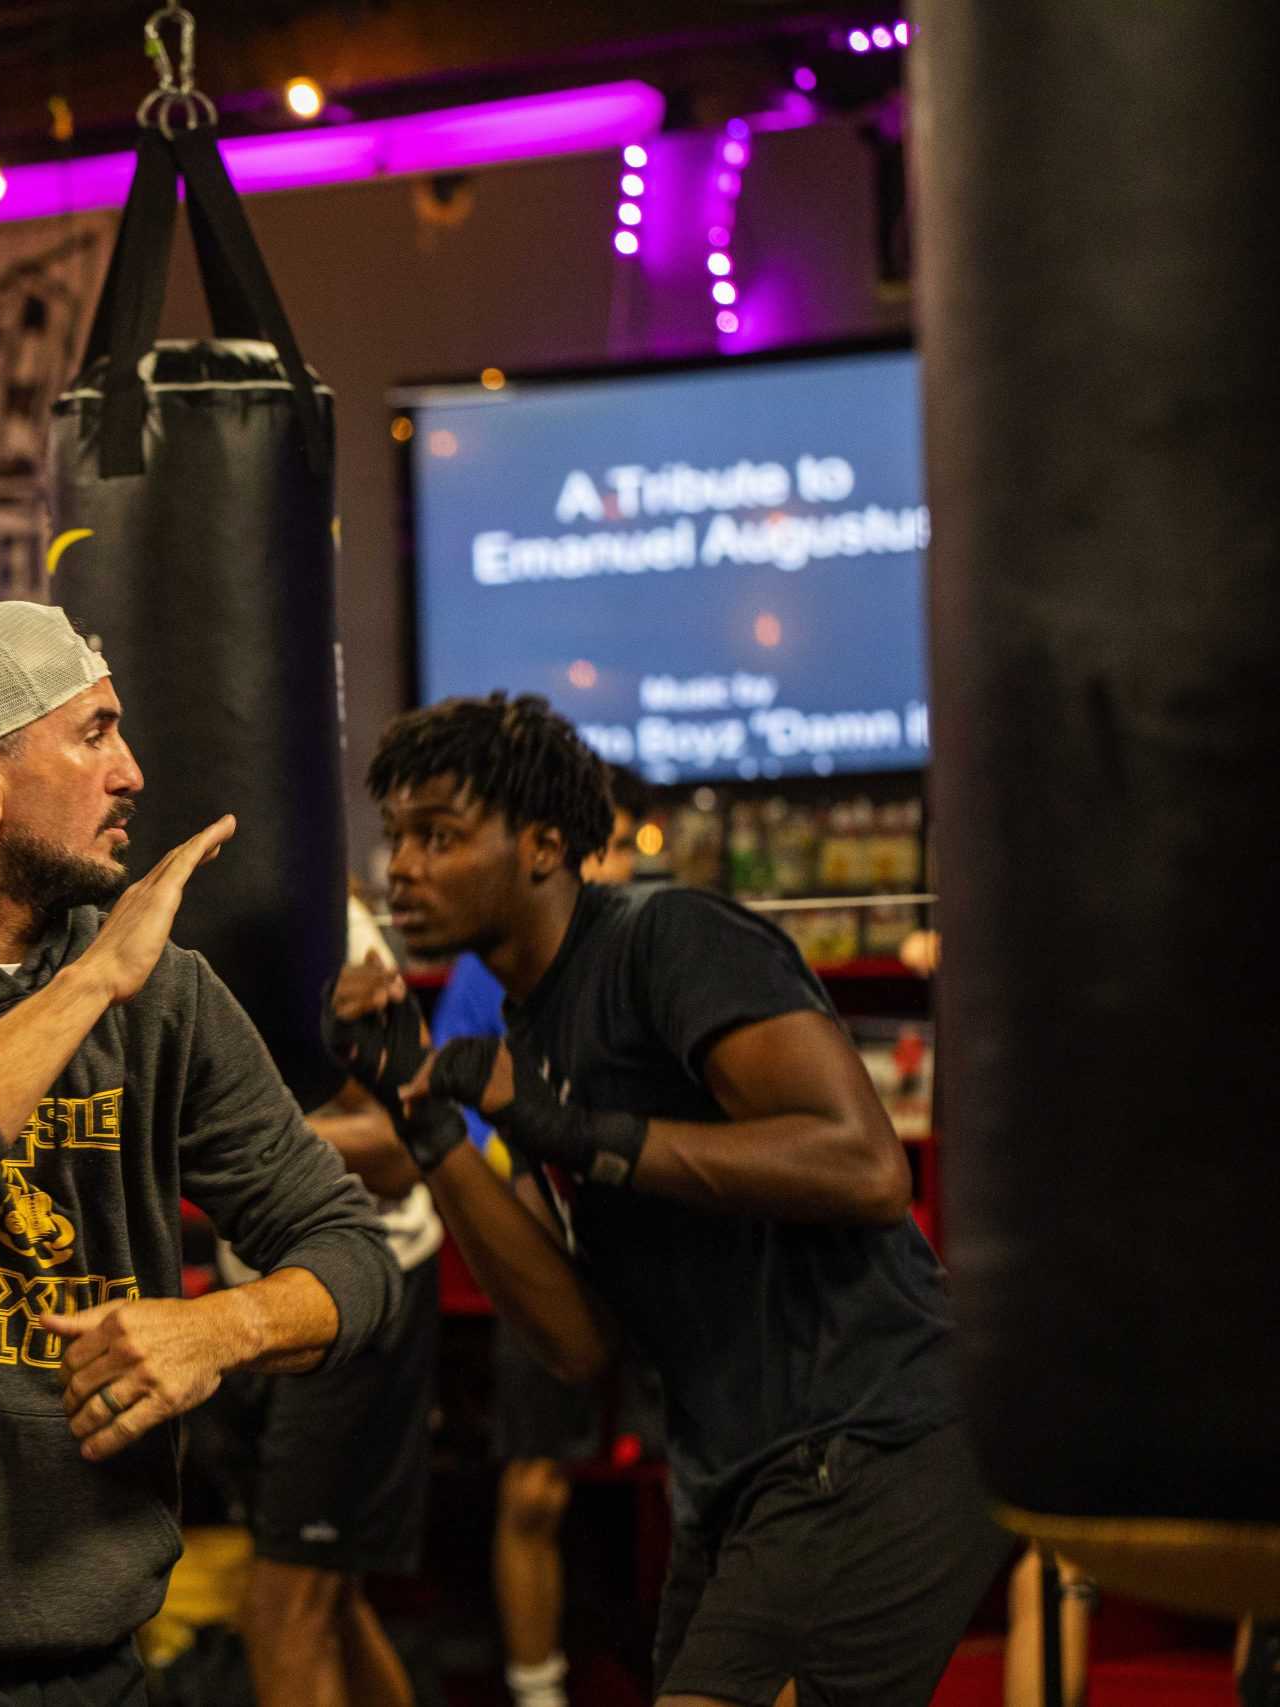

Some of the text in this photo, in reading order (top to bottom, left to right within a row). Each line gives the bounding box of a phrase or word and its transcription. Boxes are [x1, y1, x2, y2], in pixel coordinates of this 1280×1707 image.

[556, 453, 854, 523] A Tribute to
[472, 516, 696, 585] Emanuel
